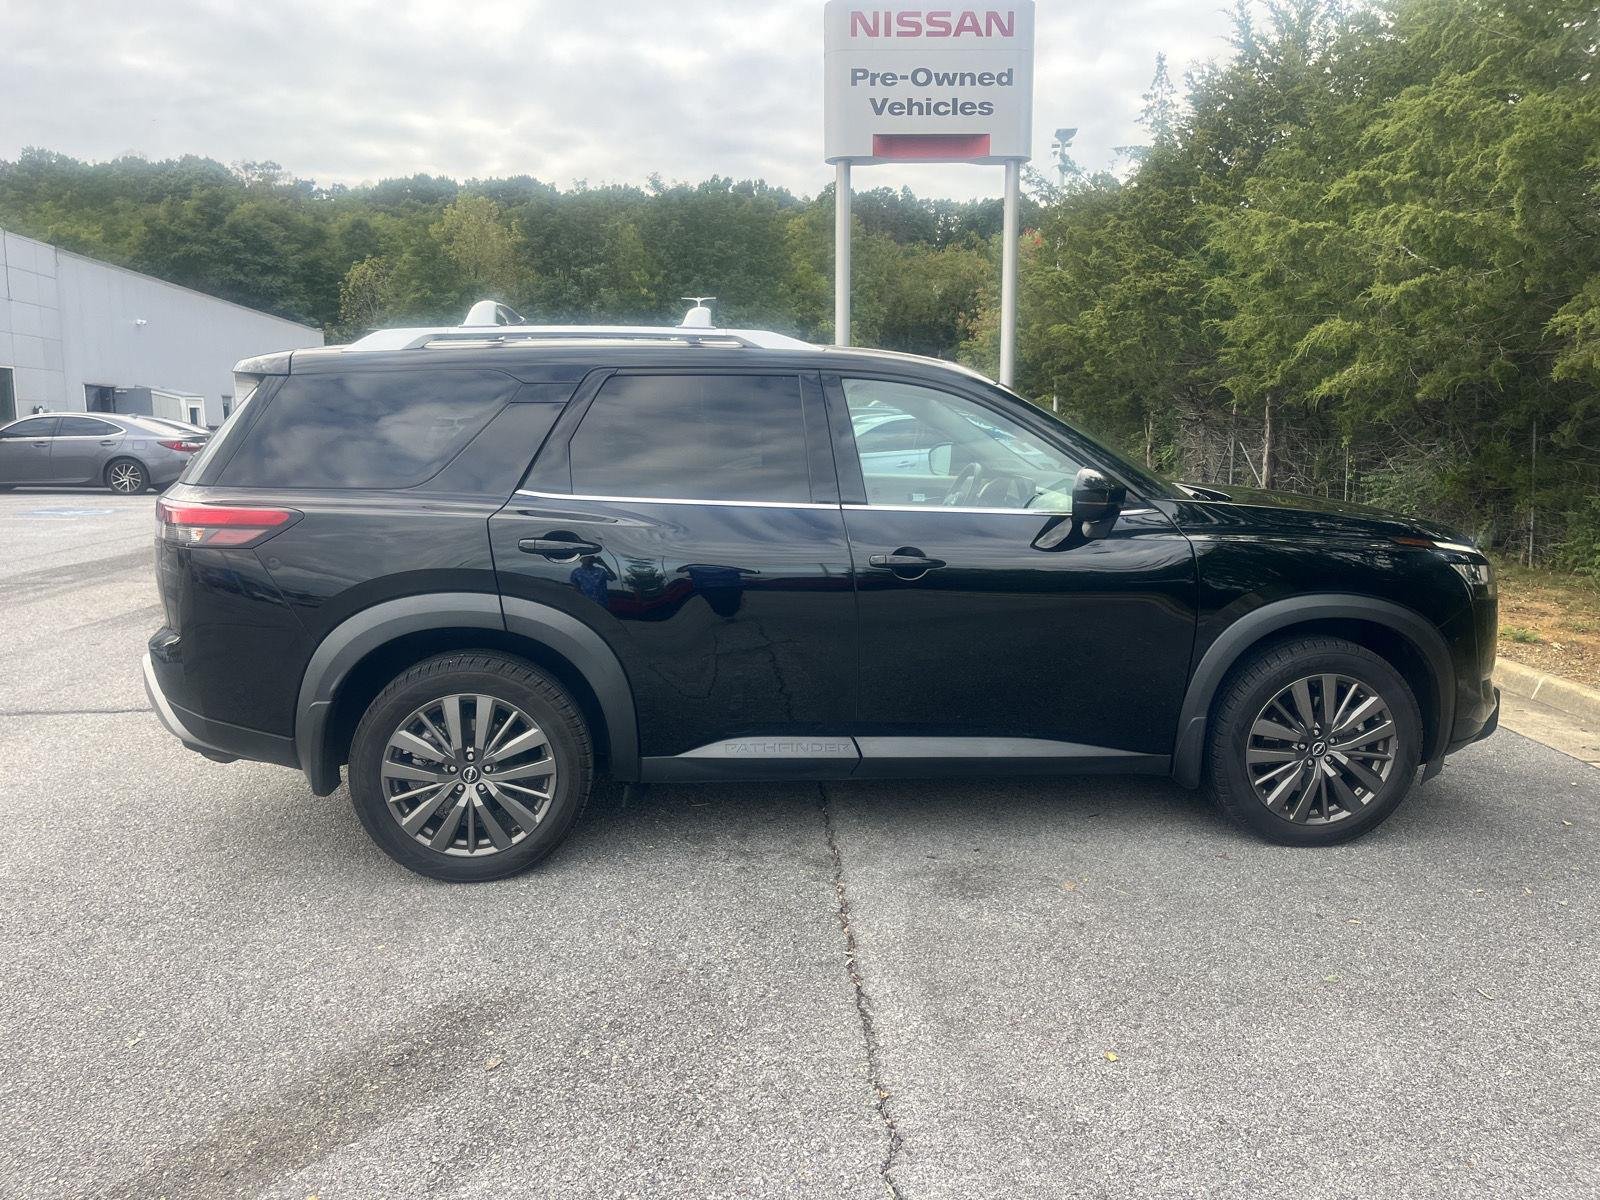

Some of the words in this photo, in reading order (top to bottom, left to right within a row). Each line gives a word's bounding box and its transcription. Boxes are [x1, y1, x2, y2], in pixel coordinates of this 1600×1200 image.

[850, 11, 1014, 37] NISSAN
[850, 68, 1013, 86] Pre-Owned
[869, 98, 994, 115] Vehicles
[724, 742, 850, 753] PATHFINDER
